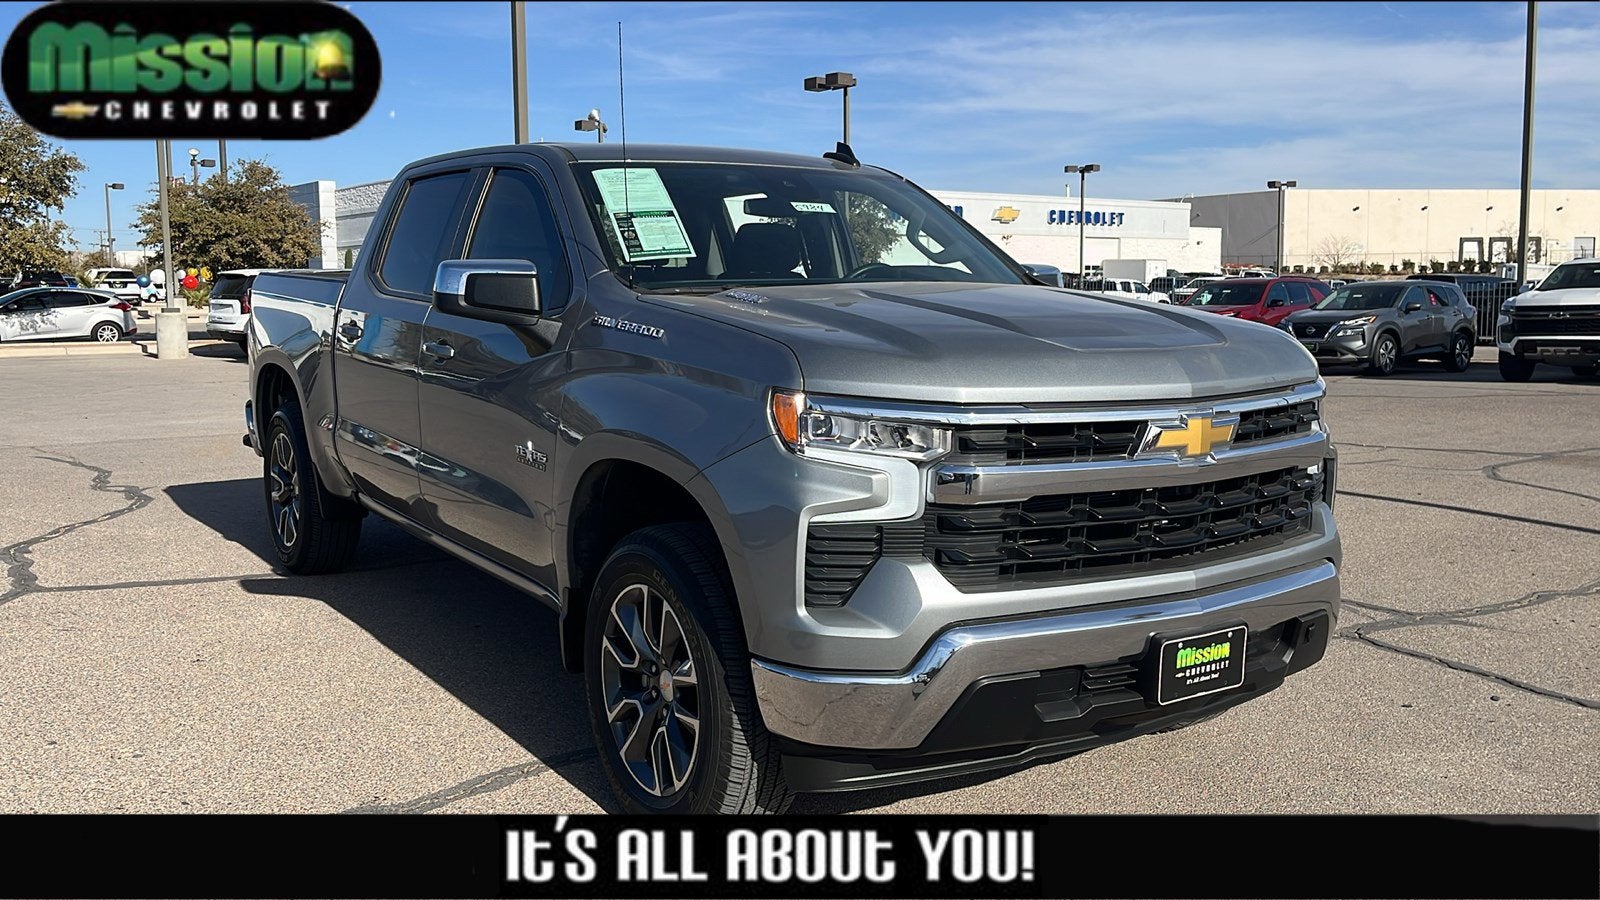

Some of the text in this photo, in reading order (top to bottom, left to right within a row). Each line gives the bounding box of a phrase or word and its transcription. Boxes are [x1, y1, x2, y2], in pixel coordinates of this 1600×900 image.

[1048, 210, 1125, 226] CHEVROLET
[593, 311, 665, 338] SILVERADO
[515, 441, 547, 463] TEXAS
[1176, 641, 1231, 669] Mission
[1185, 660, 1230, 677] CHEVROLET
